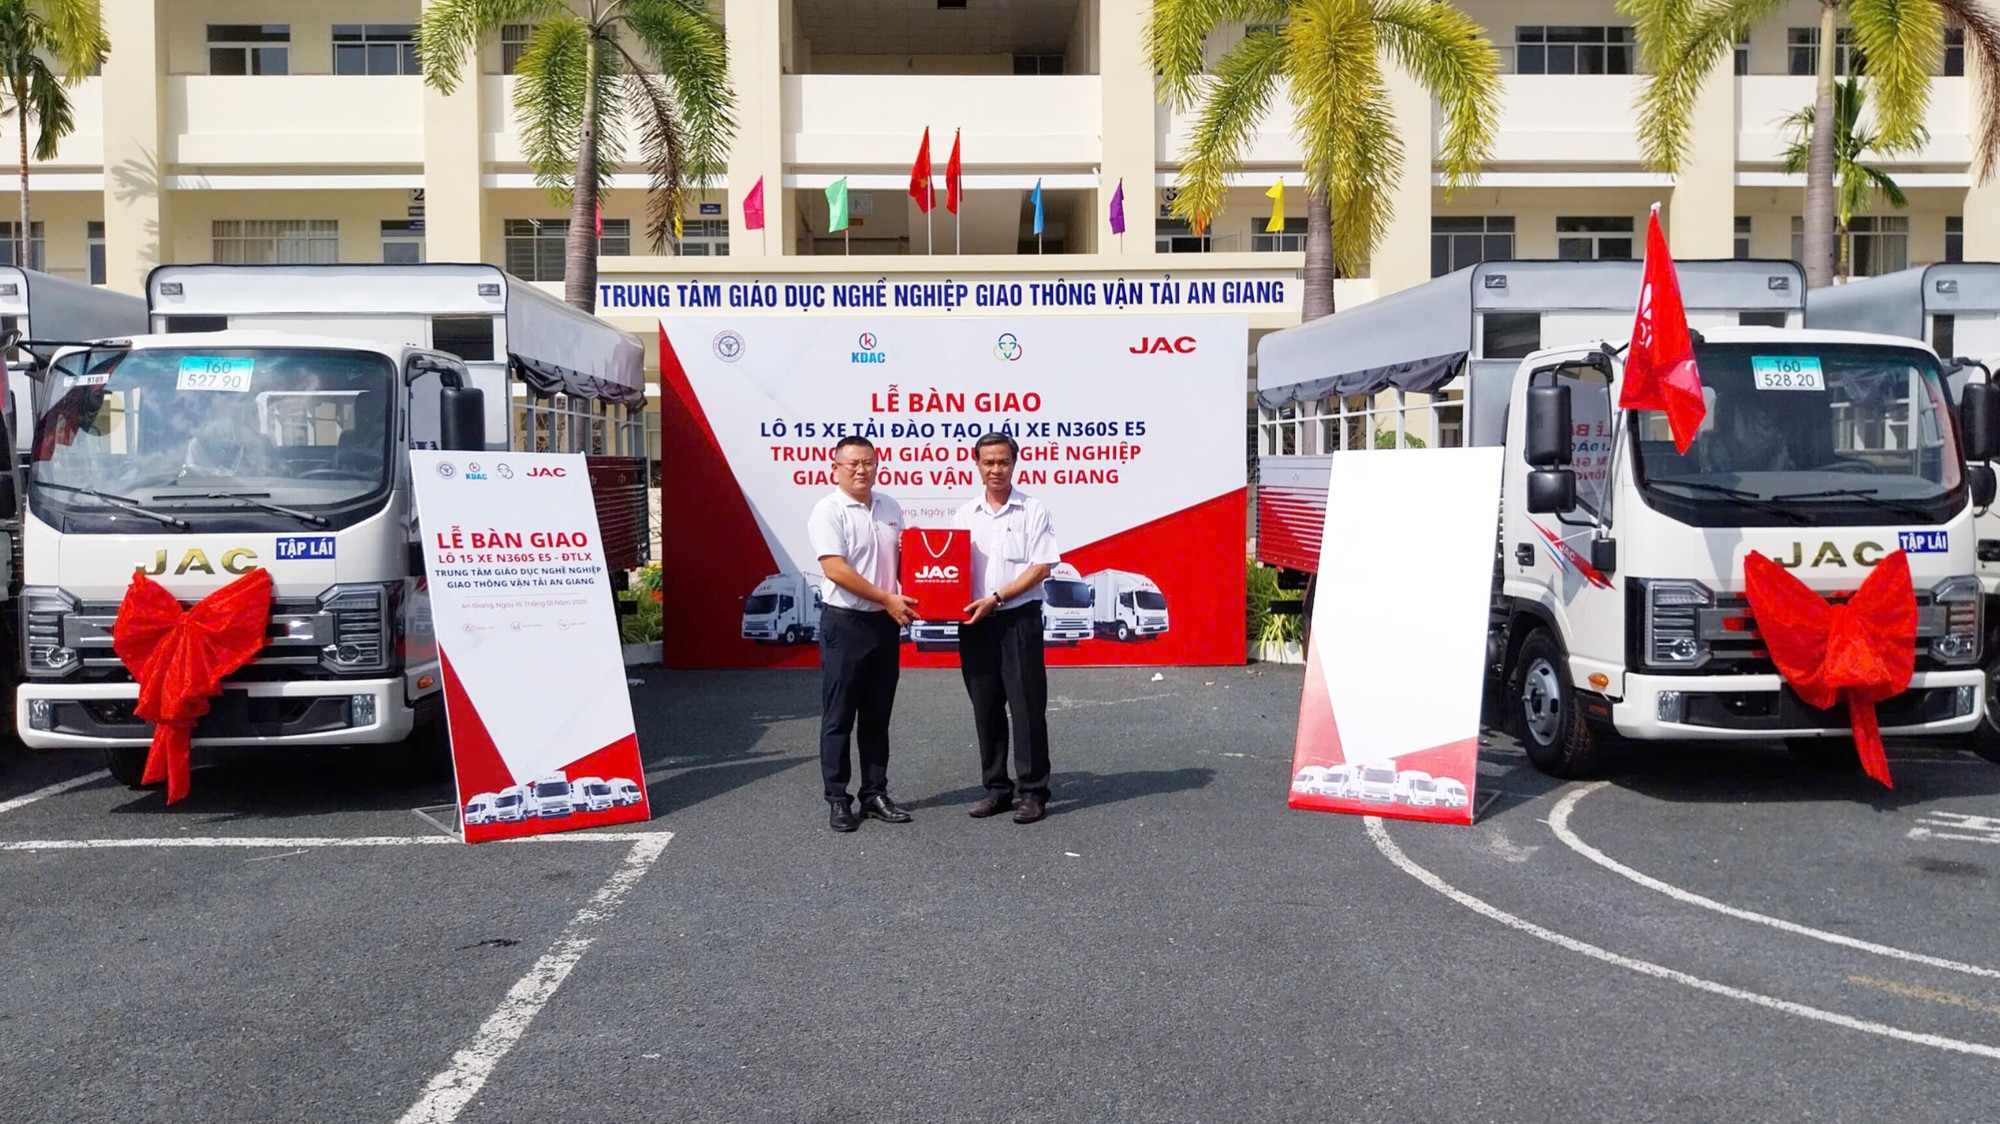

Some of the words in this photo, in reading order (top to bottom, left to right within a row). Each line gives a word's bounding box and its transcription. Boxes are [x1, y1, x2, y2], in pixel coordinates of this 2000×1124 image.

[600, 284, 670, 307] TRUNG
[677, 279, 722, 307] TÂM
[729, 280, 777, 308] GIÁO
[785, 284, 825, 312] DỤC
[833, 277, 887, 307] NGHỀ
[895, 279, 968, 311] NGHIỆP
[975, 284, 1022, 307] GIAO
[1029, 278, 1096, 306] THÔNG
[1103, 278, 1144, 310] VẬN
[1150, 274, 1180, 304] TẢI
[1187, 281, 1215, 304] AN
[1222, 281, 1284, 304] GIANG
[1129, 336, 1197, 354] JAC
[204, 360, 232, 374] T60
[851, 352, 886, 364] KDAC
[1775, 360, 1801, 373] T60
[187, 374, 242, 388] 527.90
[1764, 373, 1815, 387] 528.20
[871, 384, 900, 412] LỄ
[909, 387, 965, 412] BÀN
[974, 392, 1042, 412] GIAO
[760, 418, 787, 438] LÔ
[794, 422, 816, 438] 15
[822, 422, 847, 438] XE
[853, 417, 885, 438] TẢI
[891, 419, 935, 438] ĐÀO
[941, 422, 982, 442] TẠO
[1026, 422, 1051, 438] XE
[1057, 421, 1118, 437] N360S
[1125, 421, 1146, 436] E5
[900, 442, 950, 462] GIÁO
[1020, 441, 1059, 461] GHỀ
[1066, 441, 1141, 464] NGHIỆP
[526, 467, 566, 477] JAC
[877, 467, 923, 485] ÔNG
[930, 467, 973, 489] VẬN
[1017, 470, 1046, 485] AN
[1054, 469, 1119, 485] GIANG
[920, 507, 945, 518] Ngày
[437, 525, 464, 549] LỄ
[471, 528, 523, 549] BÀN
[530, 532, 588, 548] GIAO
[1900, 532, 1925, 552] TẬP
[1928, 531, 1947, 549] LÁI
[278, 538, 307, 558] TẬP
[310, 537, 333, 555] LÁI
[1558, 544, 1576, 562] JAC
[1773, 541, 1885, 568] JAC
[135, 548, 258, 575] JAC
[438, 552, 456, 564] LÔ
[460, 554, 474, 563] 15
[478, 554, 493, 563] XE
[497, 553, 535, 563] N360S
[539, 553, 551, 562] E5
[561, 552, 592, 561] ĐTLX
[435, 569, 470, 577] TRUNG
[472, 567, 492, 576] TÂM
[494, 567, 518, 576] GIÁO
[520, 568, 539, 578] DỤC
[542, 566, 567, 575] NGHỀ
[569, 566, 601, 575] NGHIỆP
[914, 565, 959, 579] JAC
[447, 580, 471, 588] GIAO
[474, 578, 508, 588] THÔNG
[511, 578, 530, 589] VẬN
[532, 577, 547, 587] TẢI
[550, 578, 563, 586] AN
[565, 577, 595, 586] GIANG
